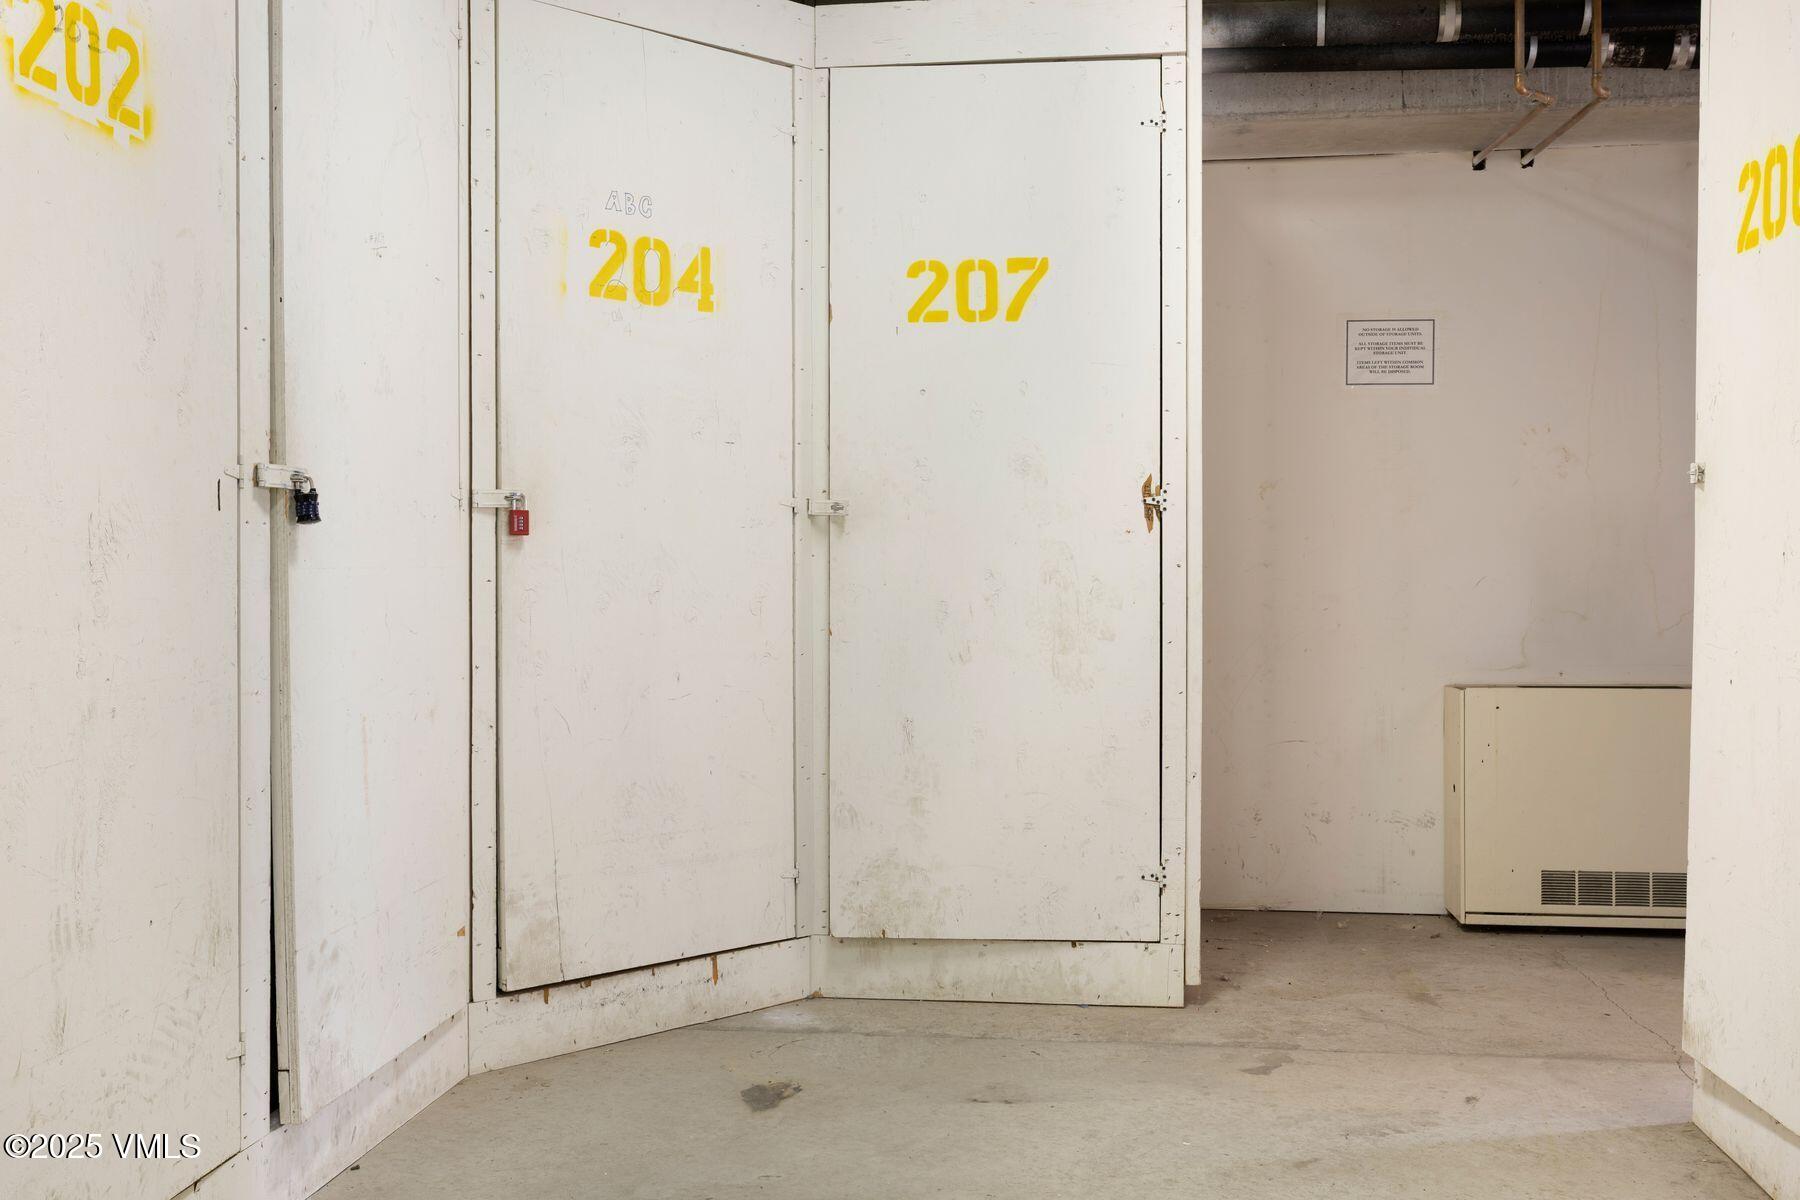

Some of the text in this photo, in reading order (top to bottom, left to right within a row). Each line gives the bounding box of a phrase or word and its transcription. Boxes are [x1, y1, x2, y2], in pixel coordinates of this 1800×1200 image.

[19, 0, 140, 130] 202
[605, 190, 652, 218] ABC
[589, 228, 714, 313] 204
[907, 256, 1049, 323] 207
